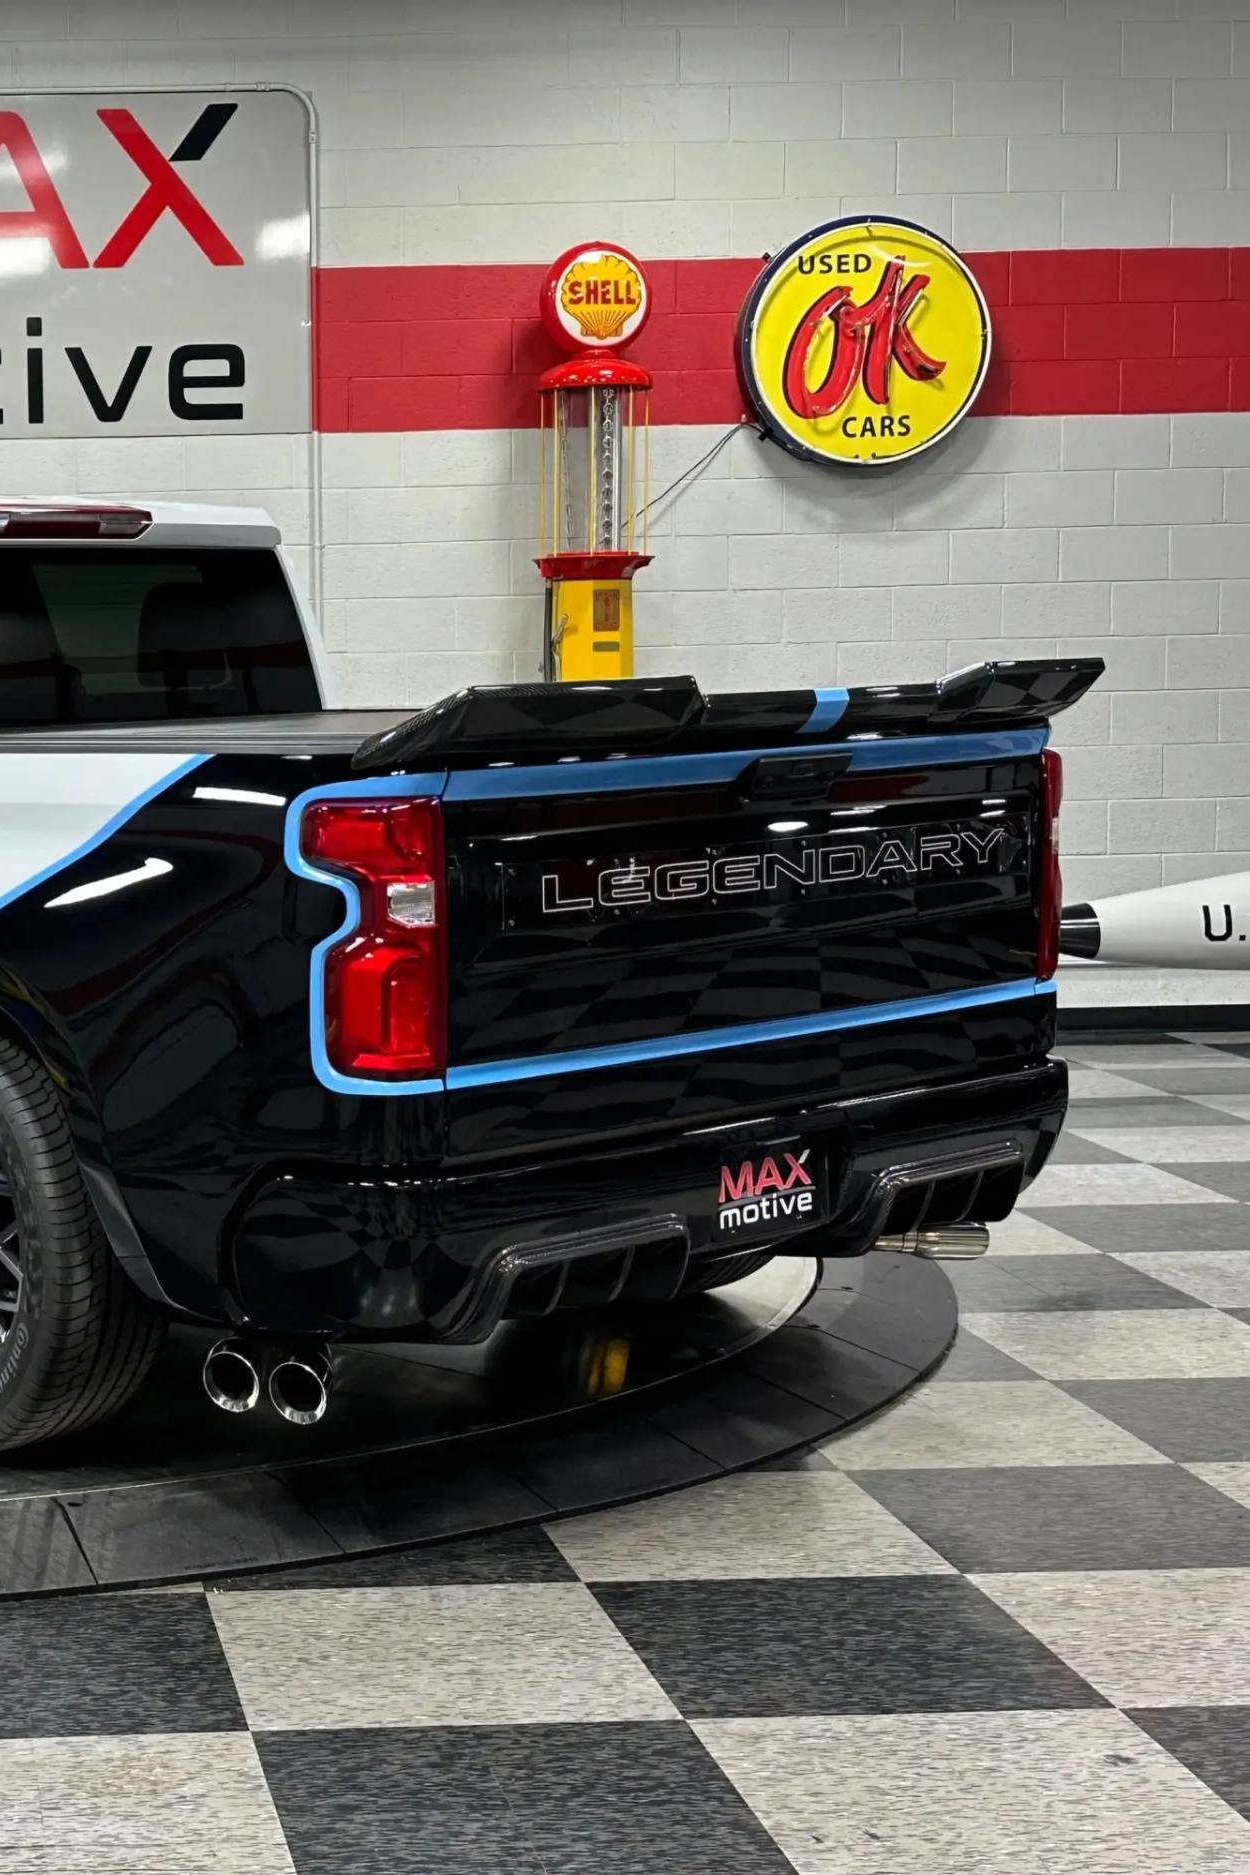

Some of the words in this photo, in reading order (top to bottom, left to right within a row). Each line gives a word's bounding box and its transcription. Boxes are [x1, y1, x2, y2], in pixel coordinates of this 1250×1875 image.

[798, 253, 872, 275] USED
[568, 280, 636, 306] SHELL
[782, 255, 947, 419] OK
[841, 414, 911, 438] CARS
[542, 828, 1004, 913] LEGENDARY
[1202, 904, 1247, 942] U.
[719, 1149, 812, 1203] MAX
[719, 1192, 812, 1230] motive
